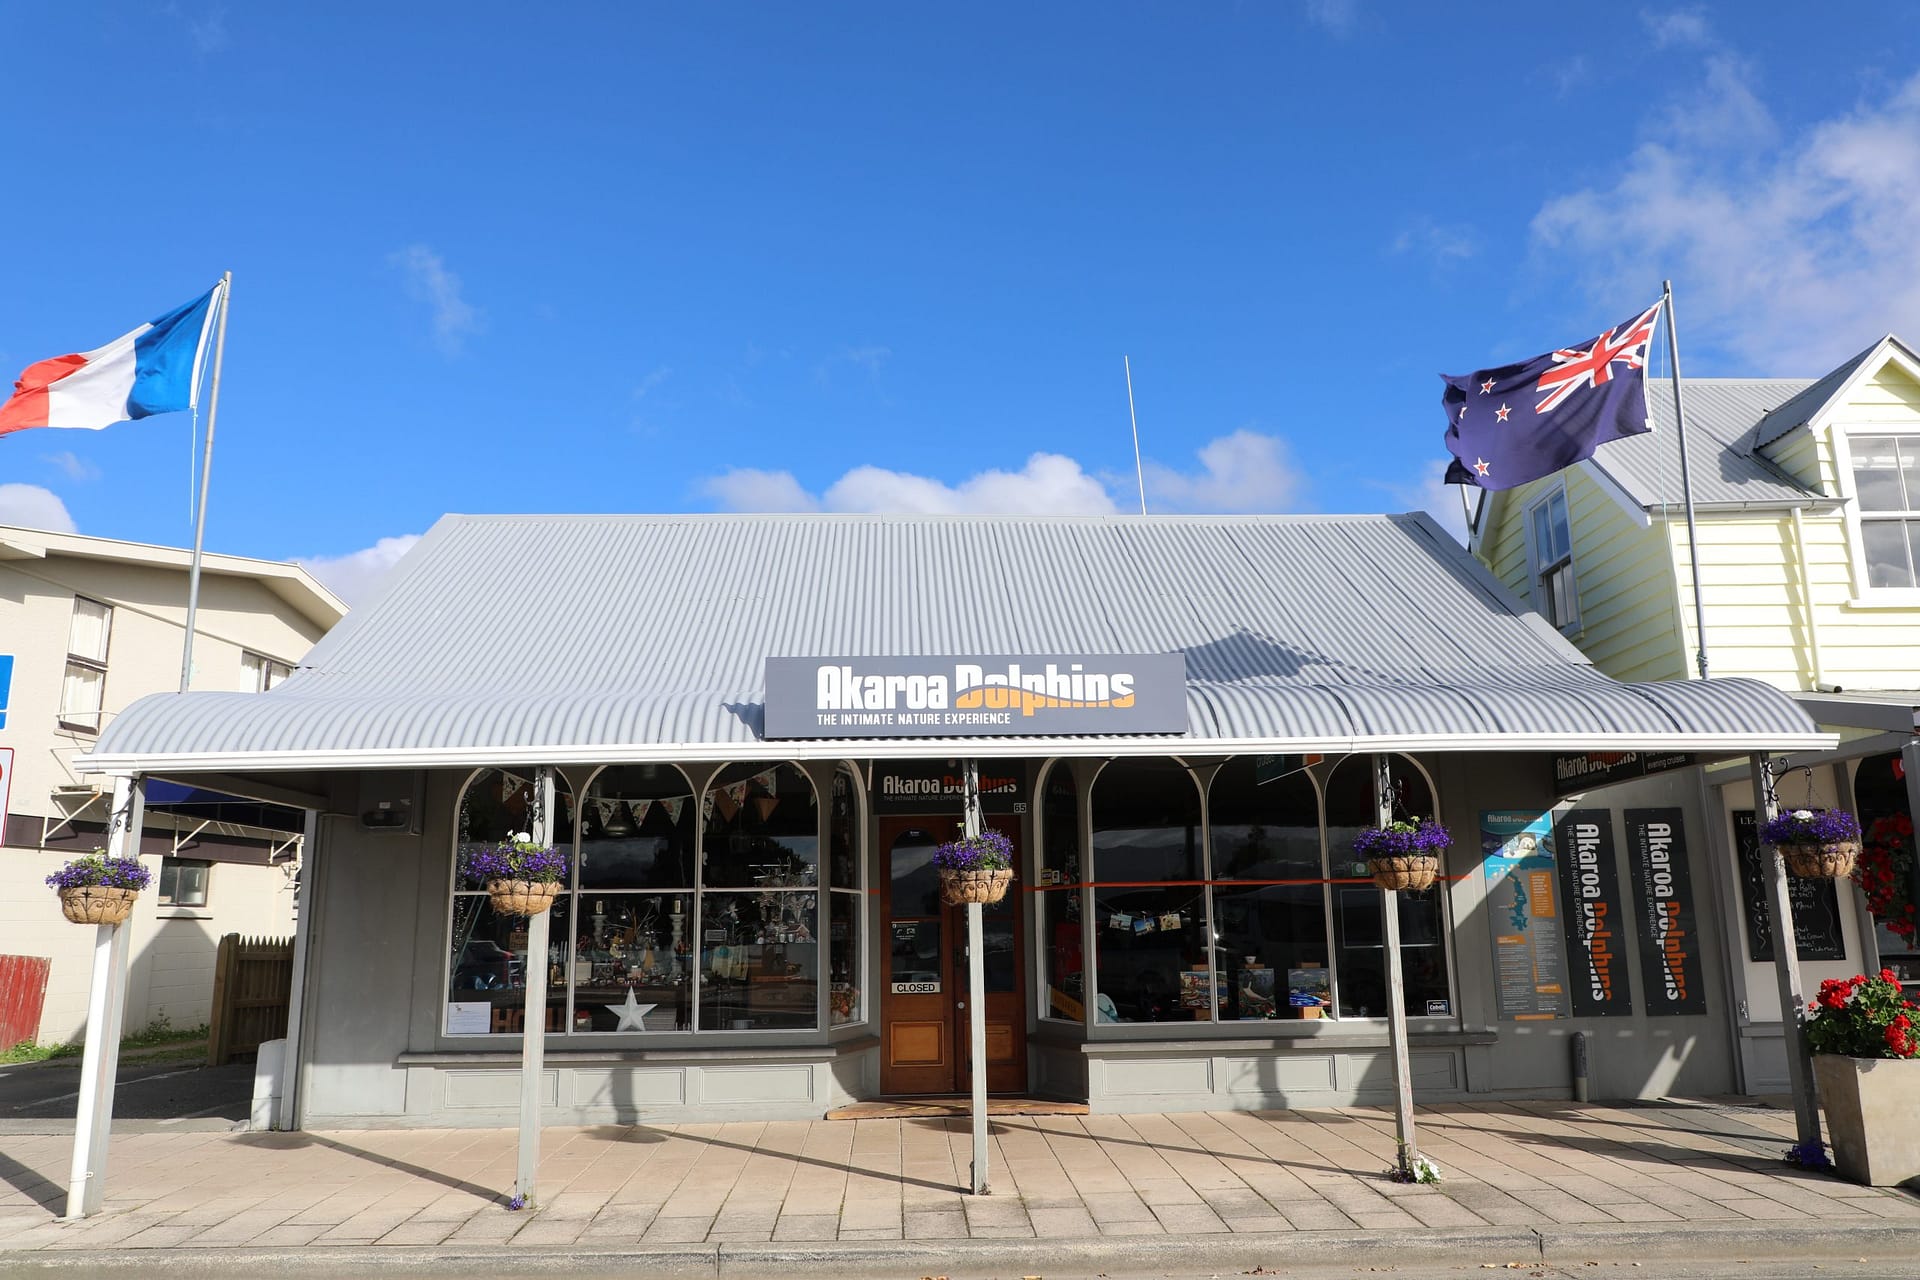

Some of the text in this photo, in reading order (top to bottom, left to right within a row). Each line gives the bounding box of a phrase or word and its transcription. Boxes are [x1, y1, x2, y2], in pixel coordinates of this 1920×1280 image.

[817, 663, 1135, 716] Akaroa Dolphins
[817, 713, 1011, 725] THE INTIMATE NATURE EXPERIENCE
[1557, 756, 1588, 780] Akaroa
[883, 776, 940, 794] Akaroa
[1014, 804, 1026, 812] 65
[1568, 838, 1578, 868] INTIMATE
[1640, 838, 1650, 868] INTIMATE
[1572, 870, 1581, 896] NATURE
[1643, 869, 1653, 896] NATURE
[1574, 898, 1585, 938] EXPERIENCE
[1576, 823, 1613, 1001] Akaroa Dolphins
[1646, 898, 1658, 938] EXPERIENCE
[1648, 823, 1688, 1001] Akaroa Dolphins
[897, 984, 935, 992] CLOSED
